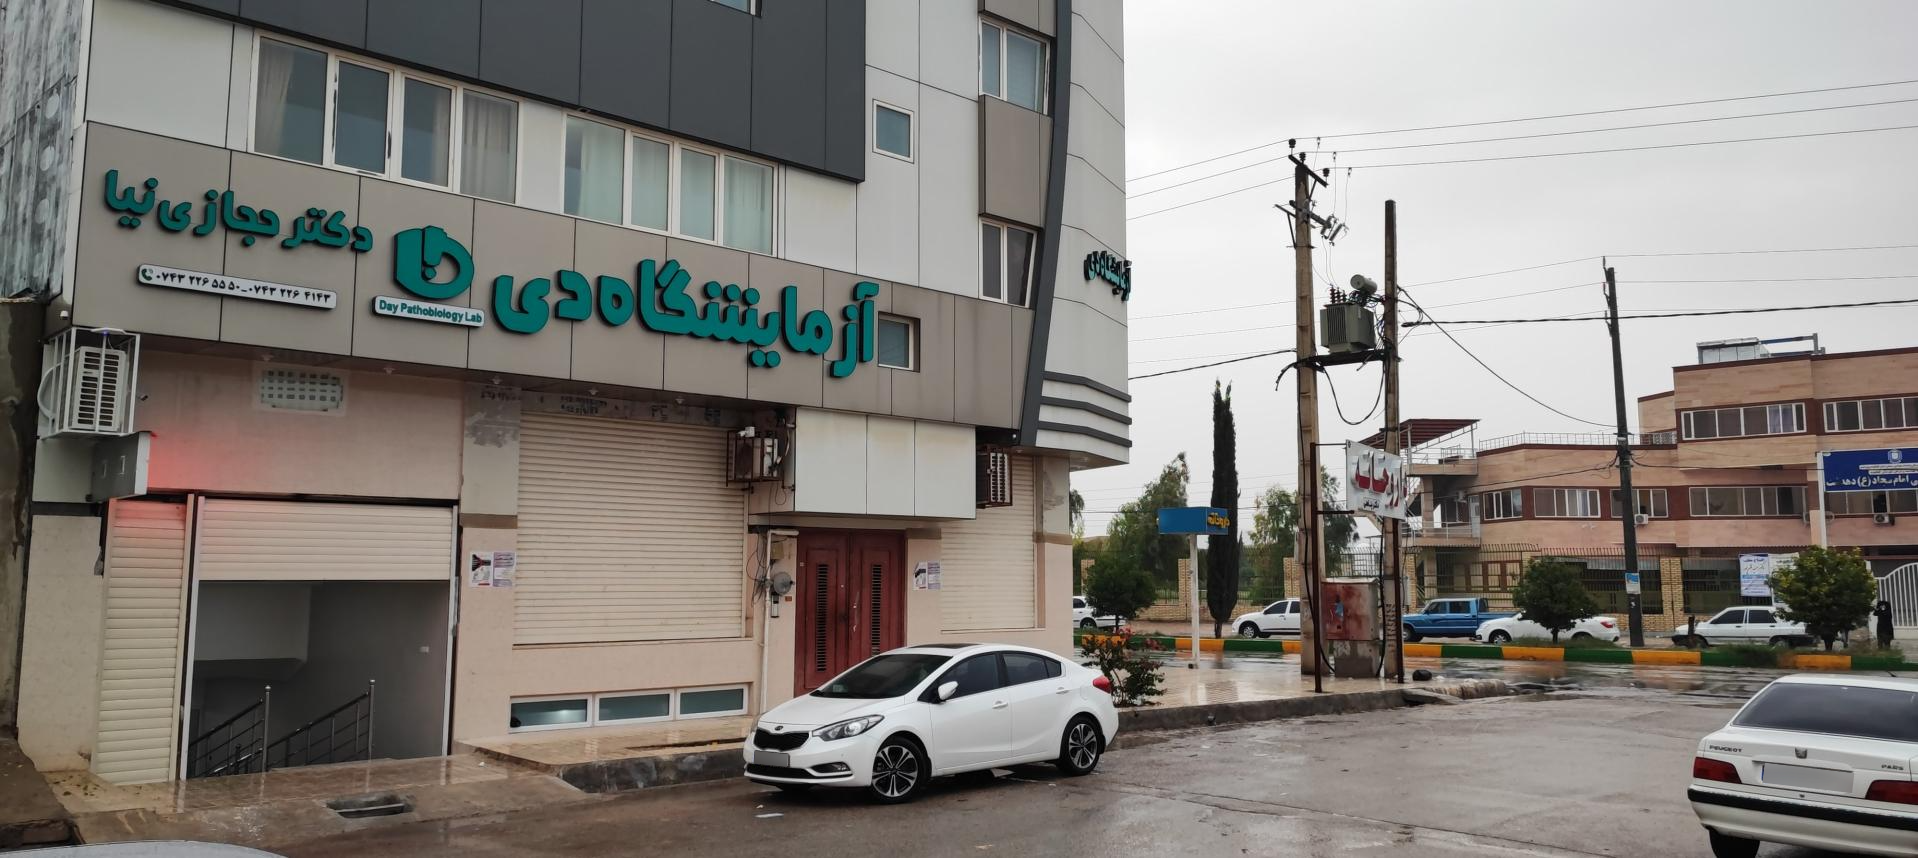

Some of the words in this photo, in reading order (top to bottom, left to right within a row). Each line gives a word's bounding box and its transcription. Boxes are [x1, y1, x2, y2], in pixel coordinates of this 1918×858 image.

[104, 169, 158, 229] نیا
[157, 189, 280, 246] حجازی
[281, 207, 374, 252] دکتر
[304, 291, 331, 304] ۴۱۴۳
[379, 299, 399, 314] Day
[400, 302, 464, 323] Pathobiology
[465, 311, 483, 323] Lab
[492, 269, 593, 335] دی
[598, 258, 880, 379] آزمایشگاه
[1709, 744, 1742, 753] PEUGEOT
